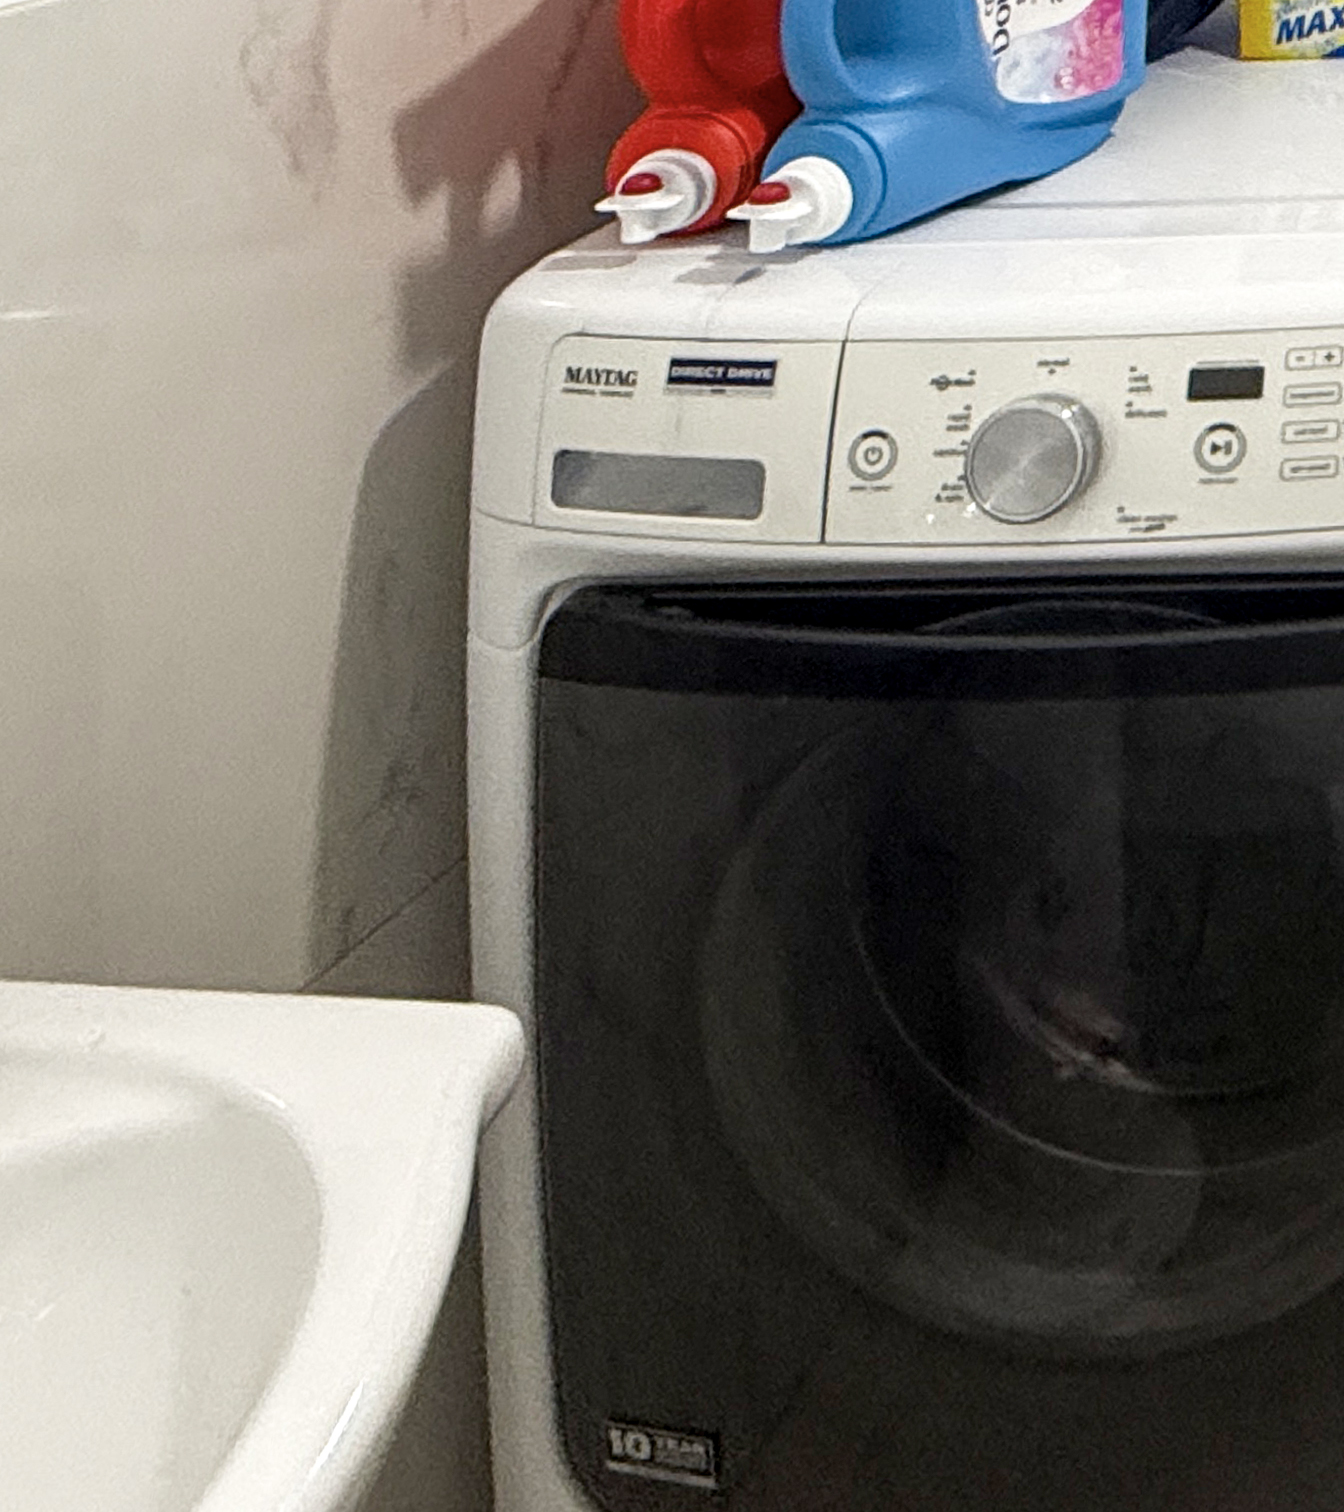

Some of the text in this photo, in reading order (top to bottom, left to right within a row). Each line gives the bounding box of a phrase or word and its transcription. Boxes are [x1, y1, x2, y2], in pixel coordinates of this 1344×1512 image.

[564, 366, 638, 386] MAYTAG
[670, 365, 773, 381] DIRECT DRIVE
[608, 1428, 652, 1461] 10
